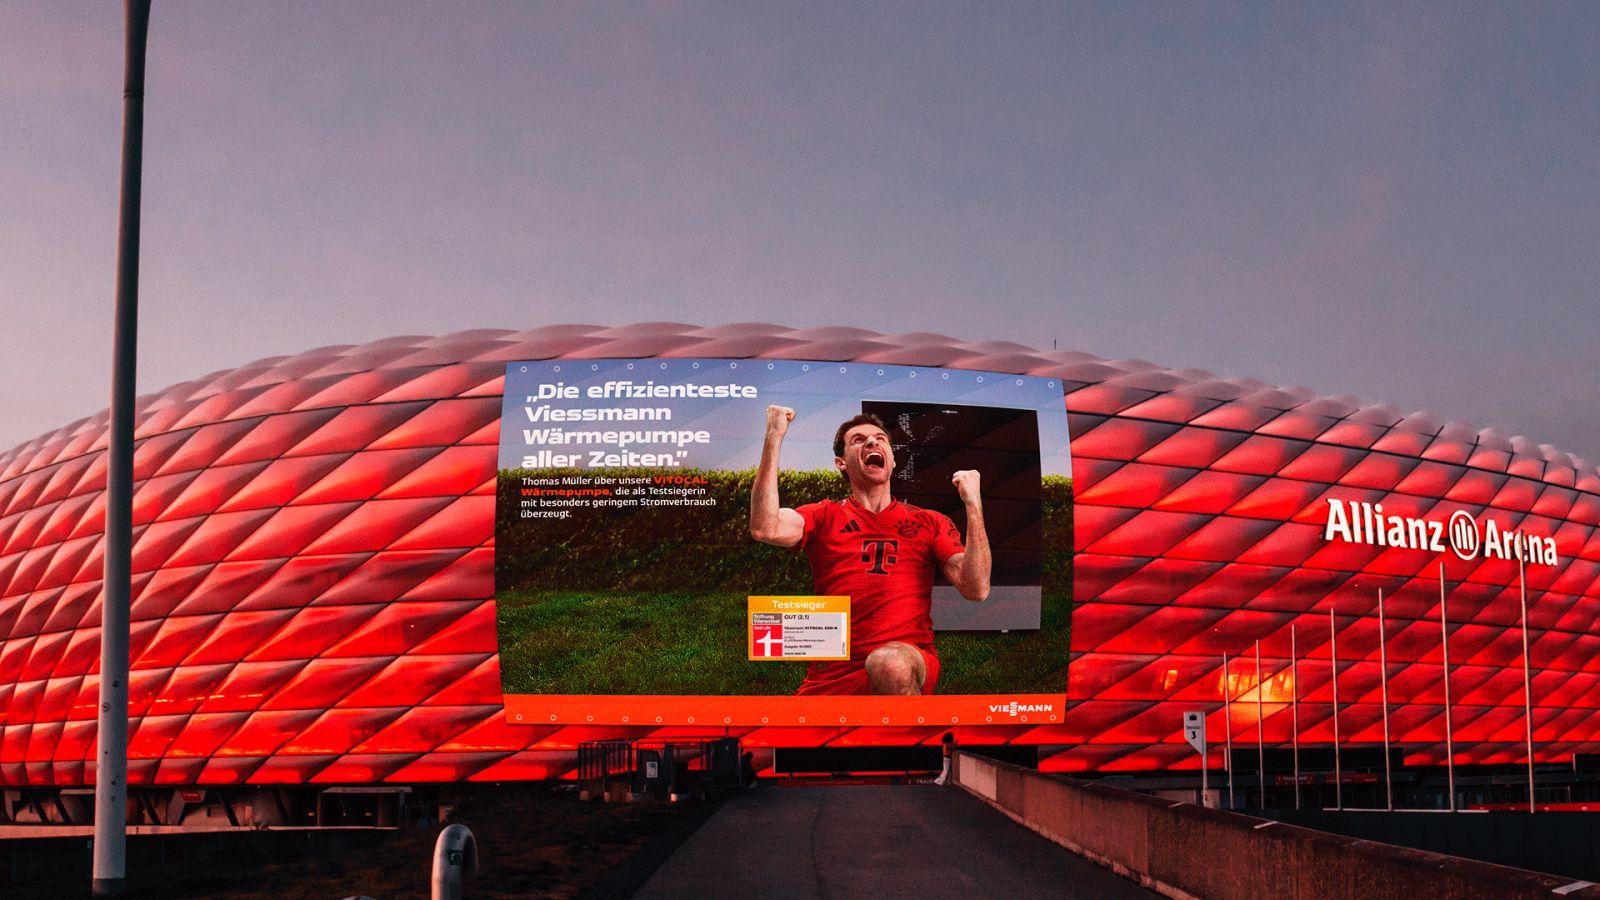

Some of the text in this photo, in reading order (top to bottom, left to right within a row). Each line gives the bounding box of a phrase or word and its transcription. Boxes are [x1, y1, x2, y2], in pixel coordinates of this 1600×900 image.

[587, 380, 757, 399] effizienteste
[524, 405, 671, 422] Viessmann
[523, 428, 711, 447] Wärmepumpe
[521, 451, 582, 468] aller
[521, 475, 709, 486] Thomas Müller über unsere VITOCAL
[520, 486, 706, 498] Wärmepumpe, die als Testsiegerin
[520, 497, 716, 508] mit besonders geringem Stromverbrauch
[520, 509, 573, 520] überzeugt.
[1325, 498, 1558, 566] Allianz Arena
[772, 600, 826, 610] Testsieger
[1191, 730, 1197, 739] 3
